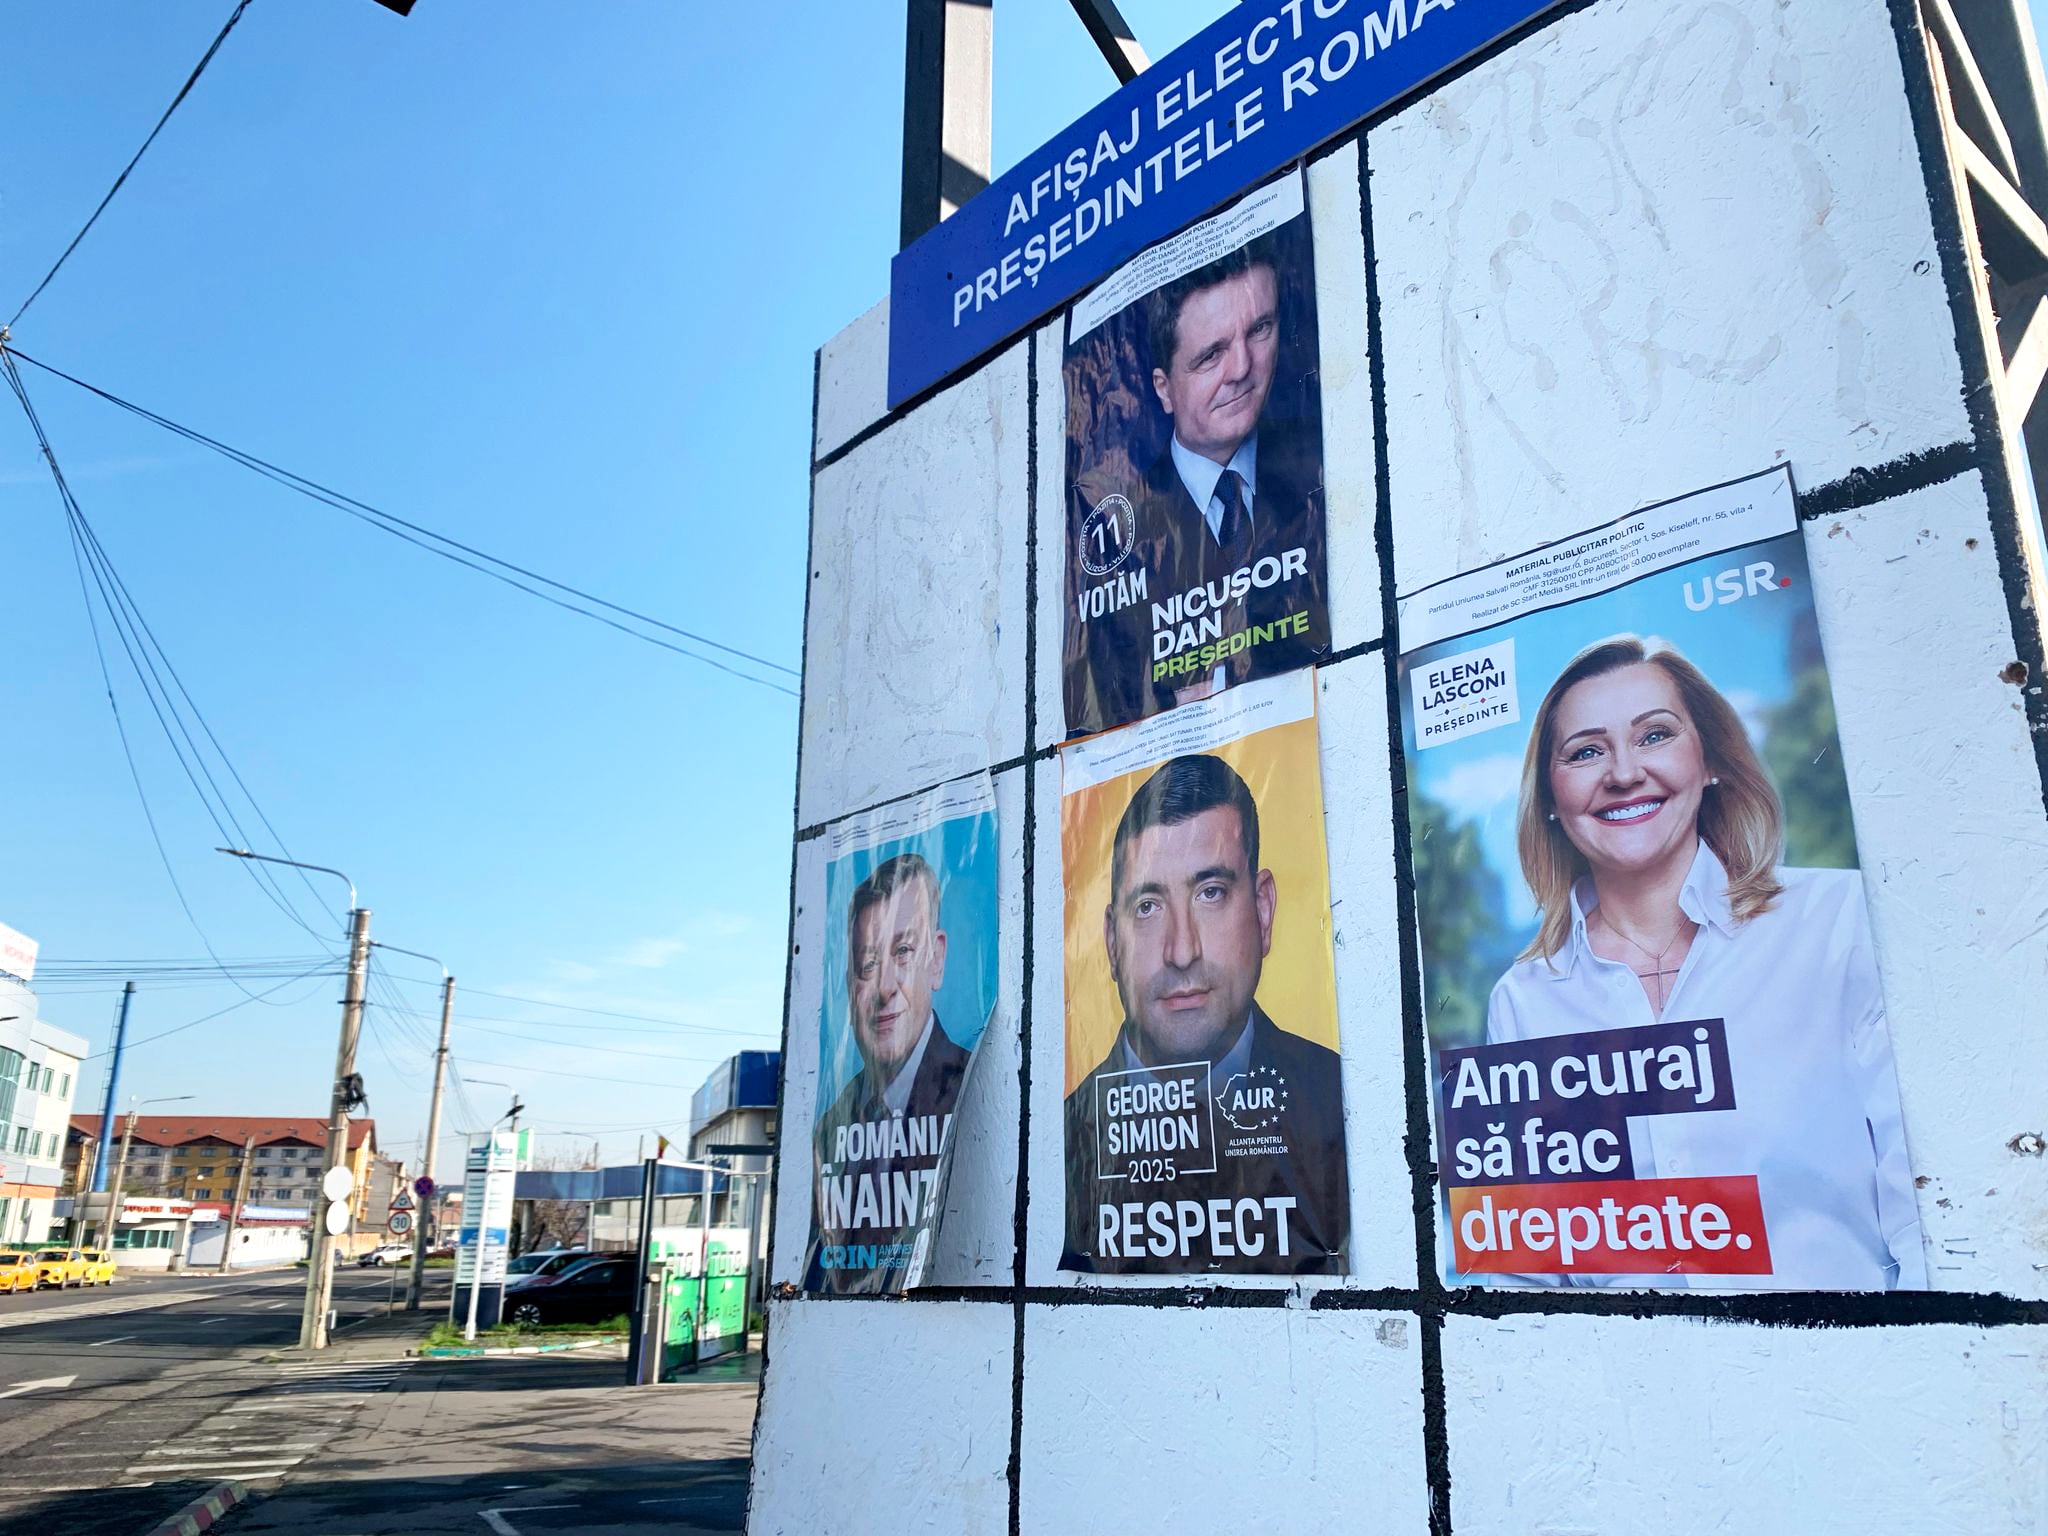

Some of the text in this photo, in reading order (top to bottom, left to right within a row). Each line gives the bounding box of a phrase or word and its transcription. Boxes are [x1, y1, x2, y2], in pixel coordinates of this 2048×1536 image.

[1004, 107, 1140, 238] AFIȘAJ
[953, 87, 1265, 328] PREȘEDINTELE
[1193, 218, 1218, 233] POLITIC
[1091, 513, 1121, 554] 11
[1506, 522, 1645, 579] MATERIAL PUBLICITAR POLITIC
[1428, 599, 1455, 615] Partidul
[1455, 593, 1485, 607] Uniunea
[1620, 538, 1642, 552] Sector
[1702, 515, 1714, 523] nr.
[1730, 506, 1746, 516] vila
[1747, 503, 1753, 511] 4
[1471, 606, 1500, 620] Realizat
[1500, 601, 1510, 611] de
[1510, 598, 1521, 609] SC
[1521, 593, 1538, 604] Start
[1538, 585, 1563, 598] Media
[1564, 580, 1580, 592] SRL
[1657, 538, 1701, 558] exemplare
[1522, 582, 1539, 594] CMF
[1540, 573, 1577, 588] 31250010
[1578, 566, 1595, 578] CPP
[1078, 567, 1148, 623] VOTĂM
[1151, 547, 1309, 631] NICUȘOR
[1152, 609, 1223, 661] DAN
[1152, 610, 1310, 683] PREȘEDINTE
[1422, 671, 1506, 711] LASCONI
[1429, 657, 1495, 689] ELENA
[1425, 702, 1509, 736] PREȘEDINTE
[1451, 1027, 1716, 1109] Am curaj
[1106, 1078, 1196, 1118] GEORGE
[1232, 1087, 1276, 1112] AUR
[1107, 1114, 1199, 1156] SIMION
[1224, 1145, 1289, 1157] UNIREA ROMÂNILOR
[1229, 1135, 1283, 1147] ALIANȚA PENTRU
[1455, 1117, 1621, 1180] să fac
[1128, 1158, 1176, 1184] 2025
[394, 1217, 407, 1229] 30
[1098, 1196, 1297, 1258] RESPECT
[1460, 1194, 1752, 1266] dreptate.
[819, 1243, 878, 1270] CRIN
